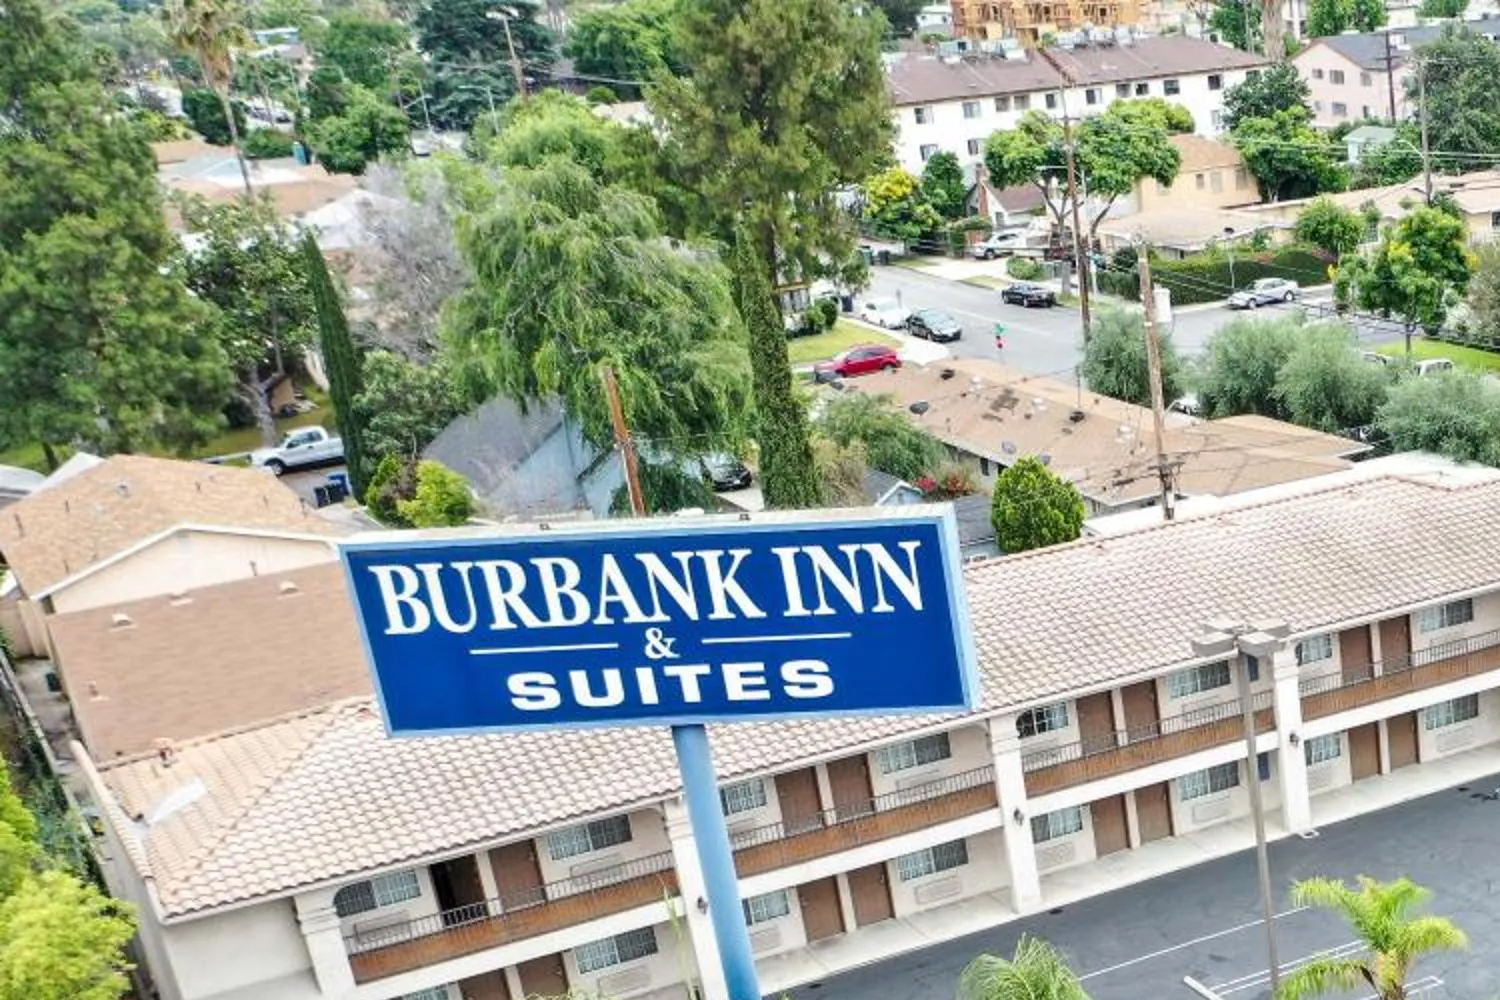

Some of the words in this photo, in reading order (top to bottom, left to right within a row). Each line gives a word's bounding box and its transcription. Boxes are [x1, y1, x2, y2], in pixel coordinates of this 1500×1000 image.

[367, 549, 767, 635] BURBANK
[771, 541, 923, 617] INN
[645, 627, 678, 659] &
[507, 659, 834, 711] SUITES
